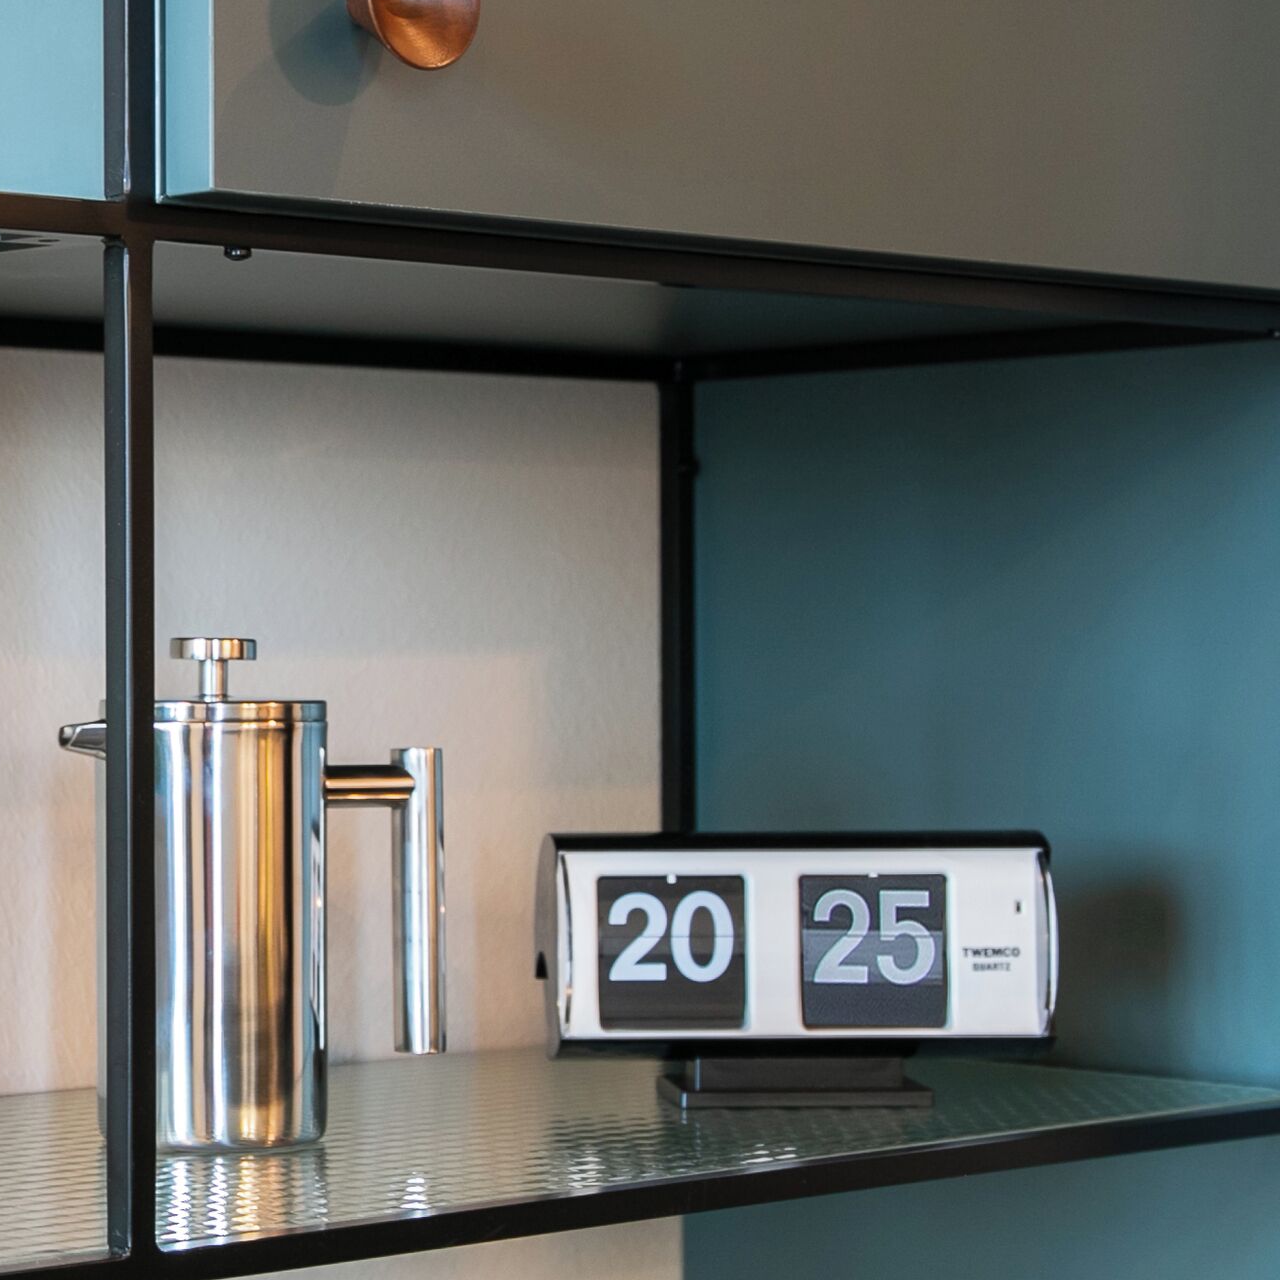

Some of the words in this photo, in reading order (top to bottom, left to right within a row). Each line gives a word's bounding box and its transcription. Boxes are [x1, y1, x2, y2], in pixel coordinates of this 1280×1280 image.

[608, 890, 734, 982] 20
[813, 889, 935, 984] 25
[963, 948, 1020, 958] TWEMCO
[972, 963, 1011, 972] QUARTZ
